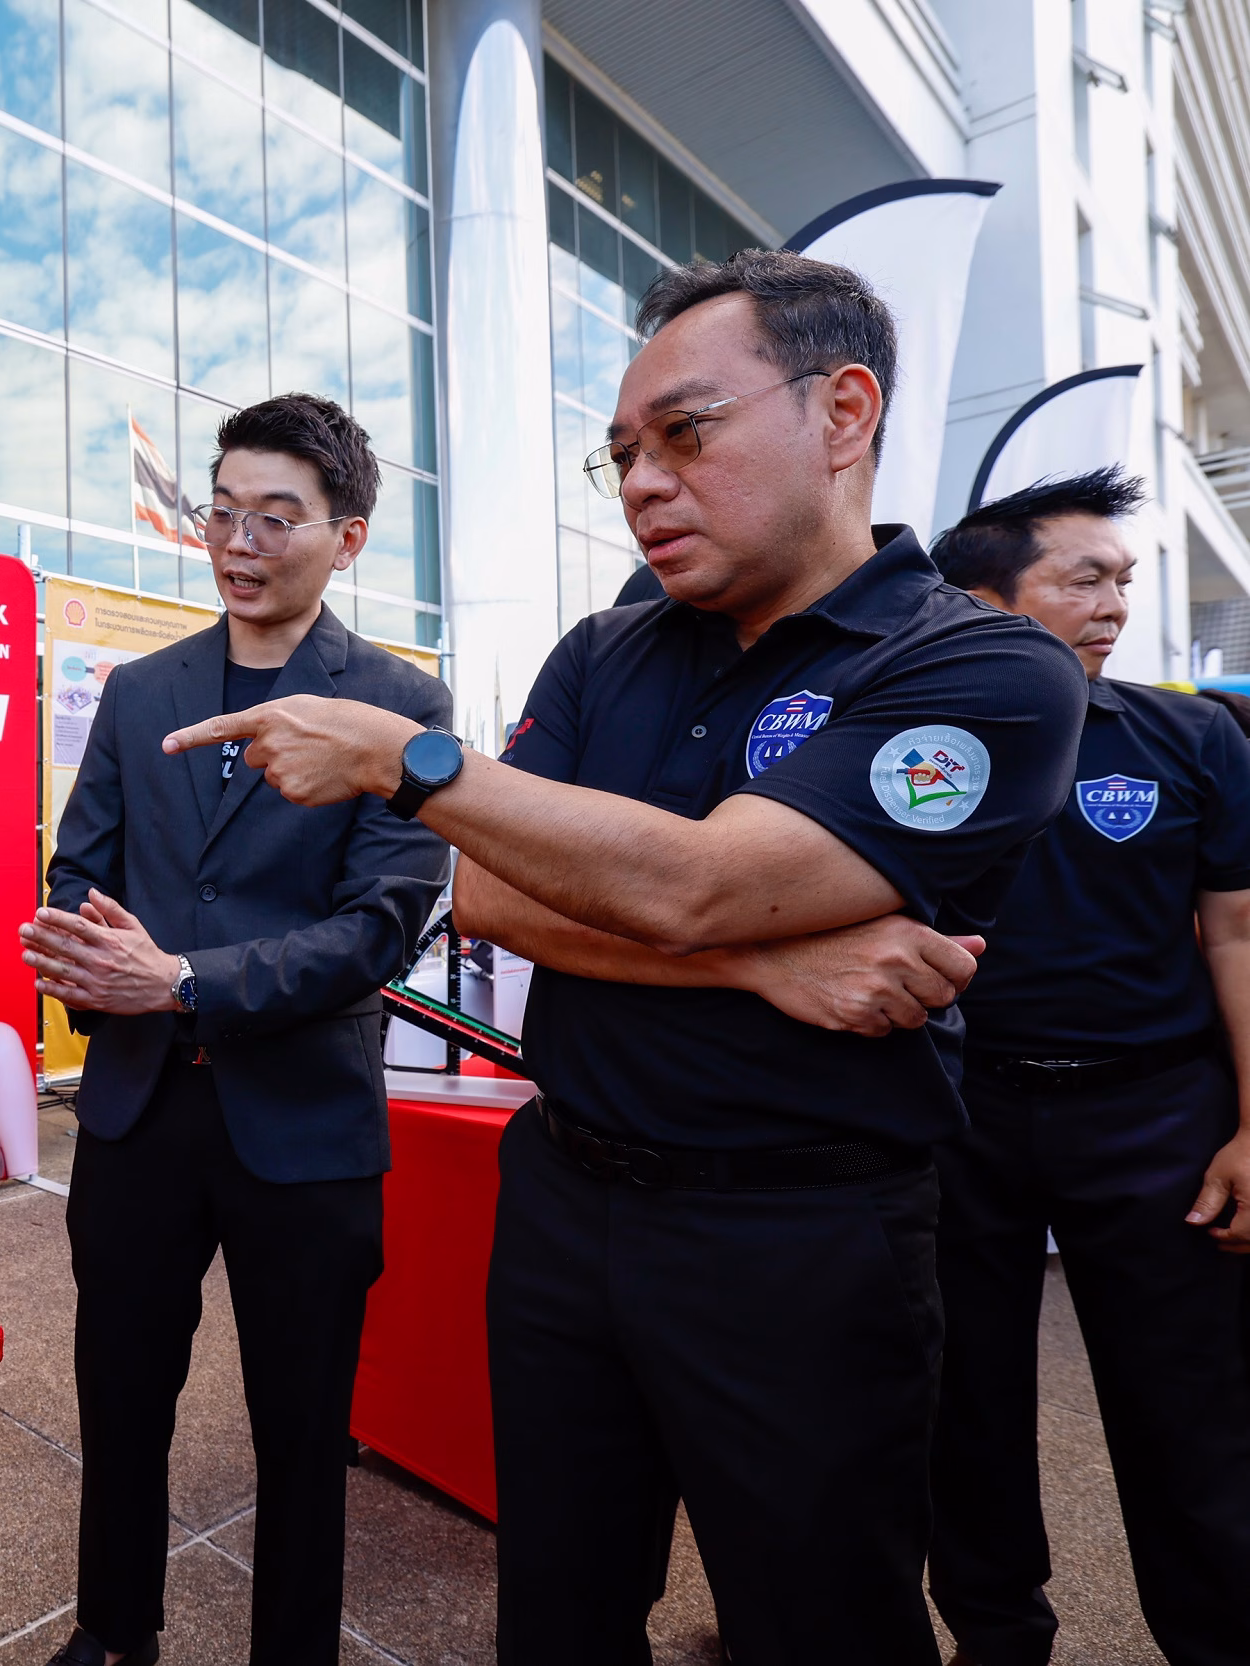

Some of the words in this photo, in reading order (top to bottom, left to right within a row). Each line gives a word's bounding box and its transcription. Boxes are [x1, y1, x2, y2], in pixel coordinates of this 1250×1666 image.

[758, 711, 827, 731] CBWM
[880, 766, 890, 784] Fuel
[881, 785, 911, 820] Dispenser
[1086, 790, 1155, 802] CBWM
[912, 814, 945, 824] Verified
